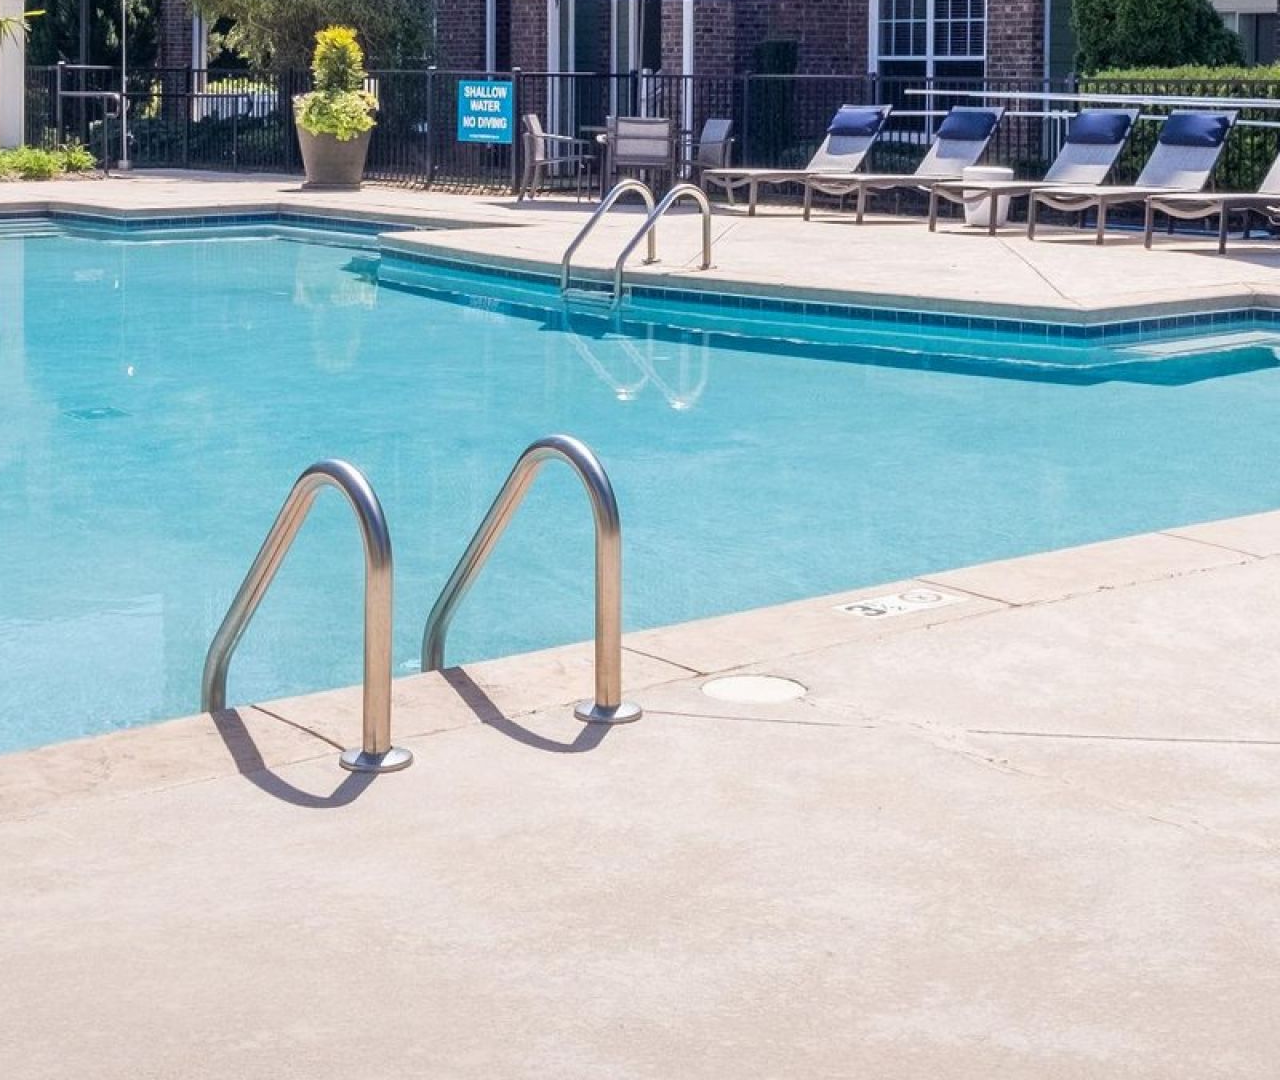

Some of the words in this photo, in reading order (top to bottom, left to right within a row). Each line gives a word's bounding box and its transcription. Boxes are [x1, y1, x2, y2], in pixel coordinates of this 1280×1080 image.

[464, 86, 507, 98] SHALLOW
[470, 100, 500, 112] WATER
[463, 115, 475, 127] NO
[478, 116, 507, 128] DIVING
